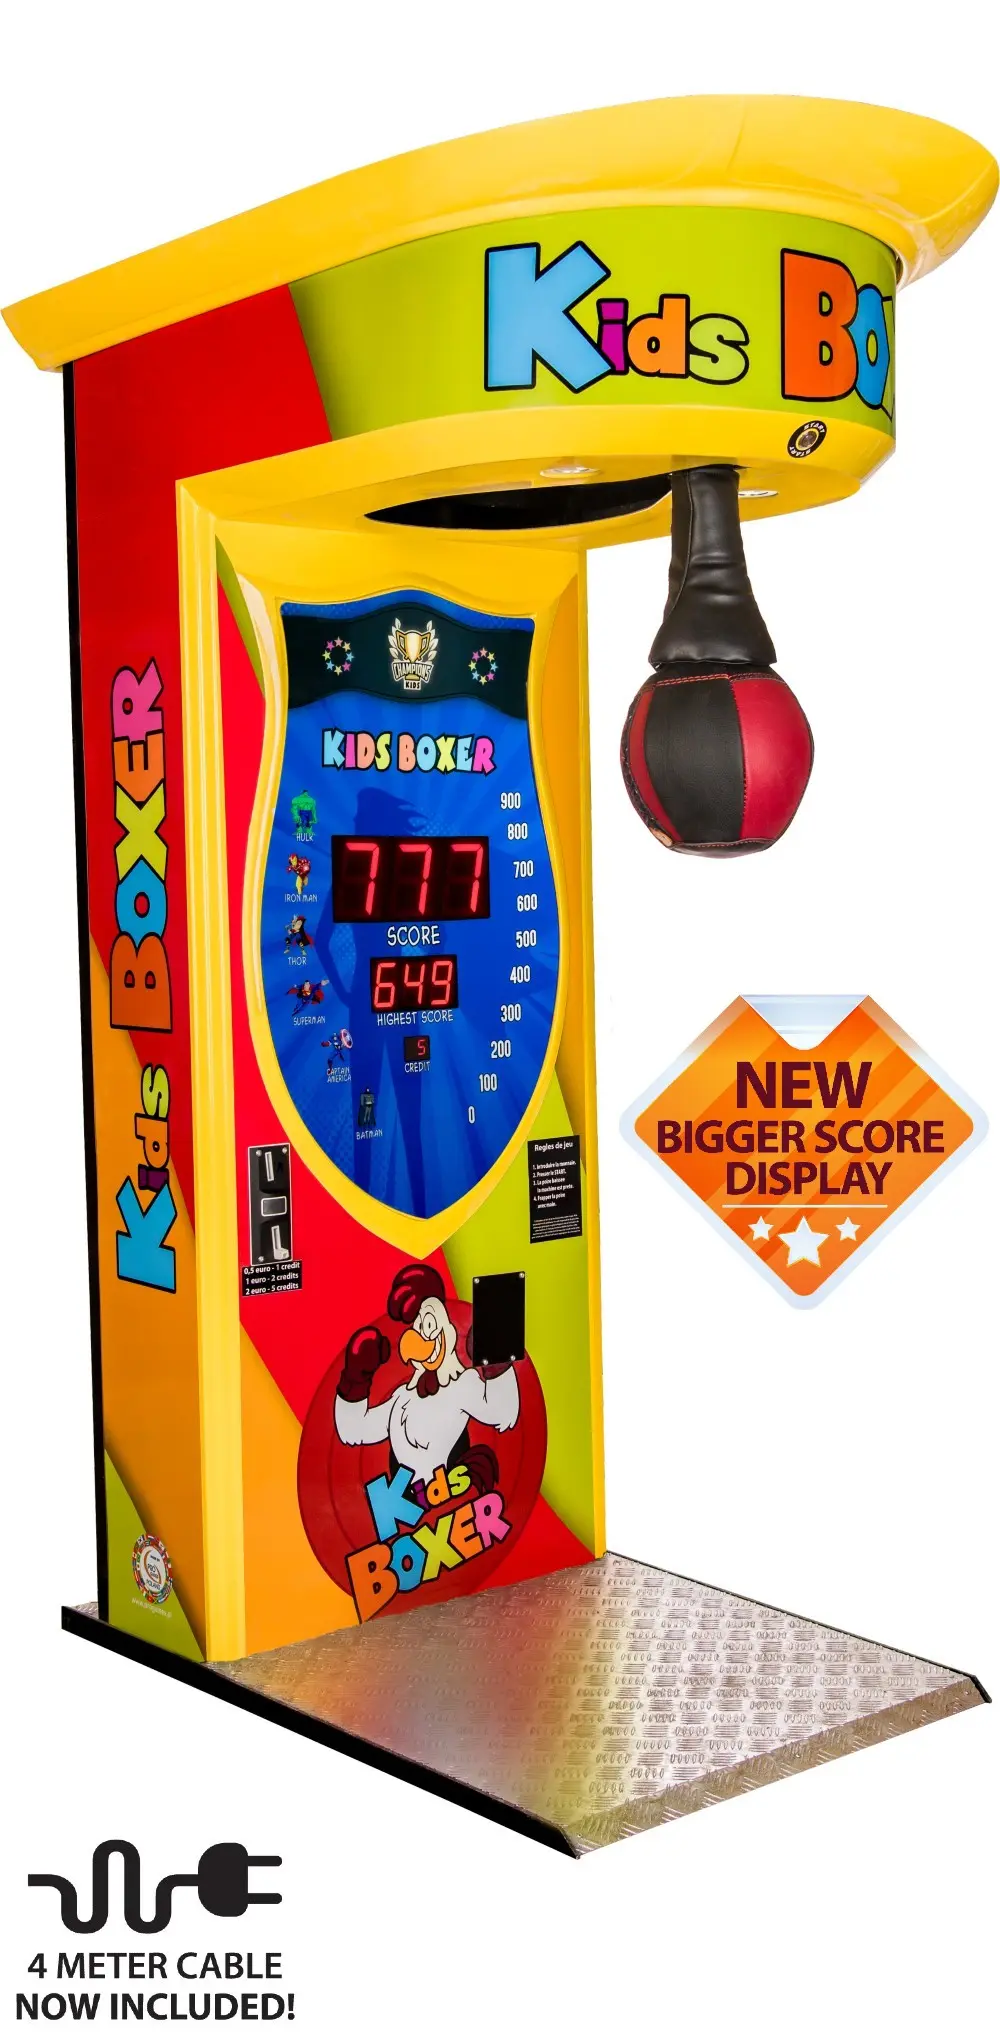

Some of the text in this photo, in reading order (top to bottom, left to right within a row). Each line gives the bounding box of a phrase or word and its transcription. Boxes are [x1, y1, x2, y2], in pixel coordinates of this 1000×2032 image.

[484, 241, 895, 421] Kids BO
[393, 662, 432, 681] CHAMPIONS
[405, 681, 420, 689] KIDS
[322, 727, 497, 776] KIDS BOXER
[500, 792, 521, 810] 900
[296, 832, 314, 842] HULK
[507, 823, 528, 841] 800
[513, 860, 534, 878] 700
[345, 842, 484, 915] 777
[284, 893, 318, 903] IRON MAN
[517, 894, 538, 912] 600
[387, 925, 440, 946] SCORE
[516, 930, 537, 948] 500
[288, 956, 307, 966] THOR
[110, 657, 177, 1294] Kids BOXER
[510, 965, 531, 984] 400
[373, 960, 453, 1008] 649
[293, 1016, 326, 1026] SUPERMAN
[377, 1010, 454, 1026] HIGHEST SCORE
[501, 1003, 521, 1023] 300
[417, 1039, 426, 1056] 5
[491, 1040, 511, 1059] 200
[326, 1066, 350, 1076] CAPTAIN
[404, 1061, 431, 1073] CREDIT
[327, 1074, 352, 1083] AMERICA
[479, 1073, 498, 1092] 100
[468, 1106, 475, 1124] 0
[356, 1129, 383, 1140] BATMAN
[243, 1266, 254, 1276] 0,5
[281, 1261, 300, 1270] credit
[276, 1272, 299, 1281] credits
[276, 1282, 299, 1291] credits
[344, 1463, 512, 1625] Kids BOXER
